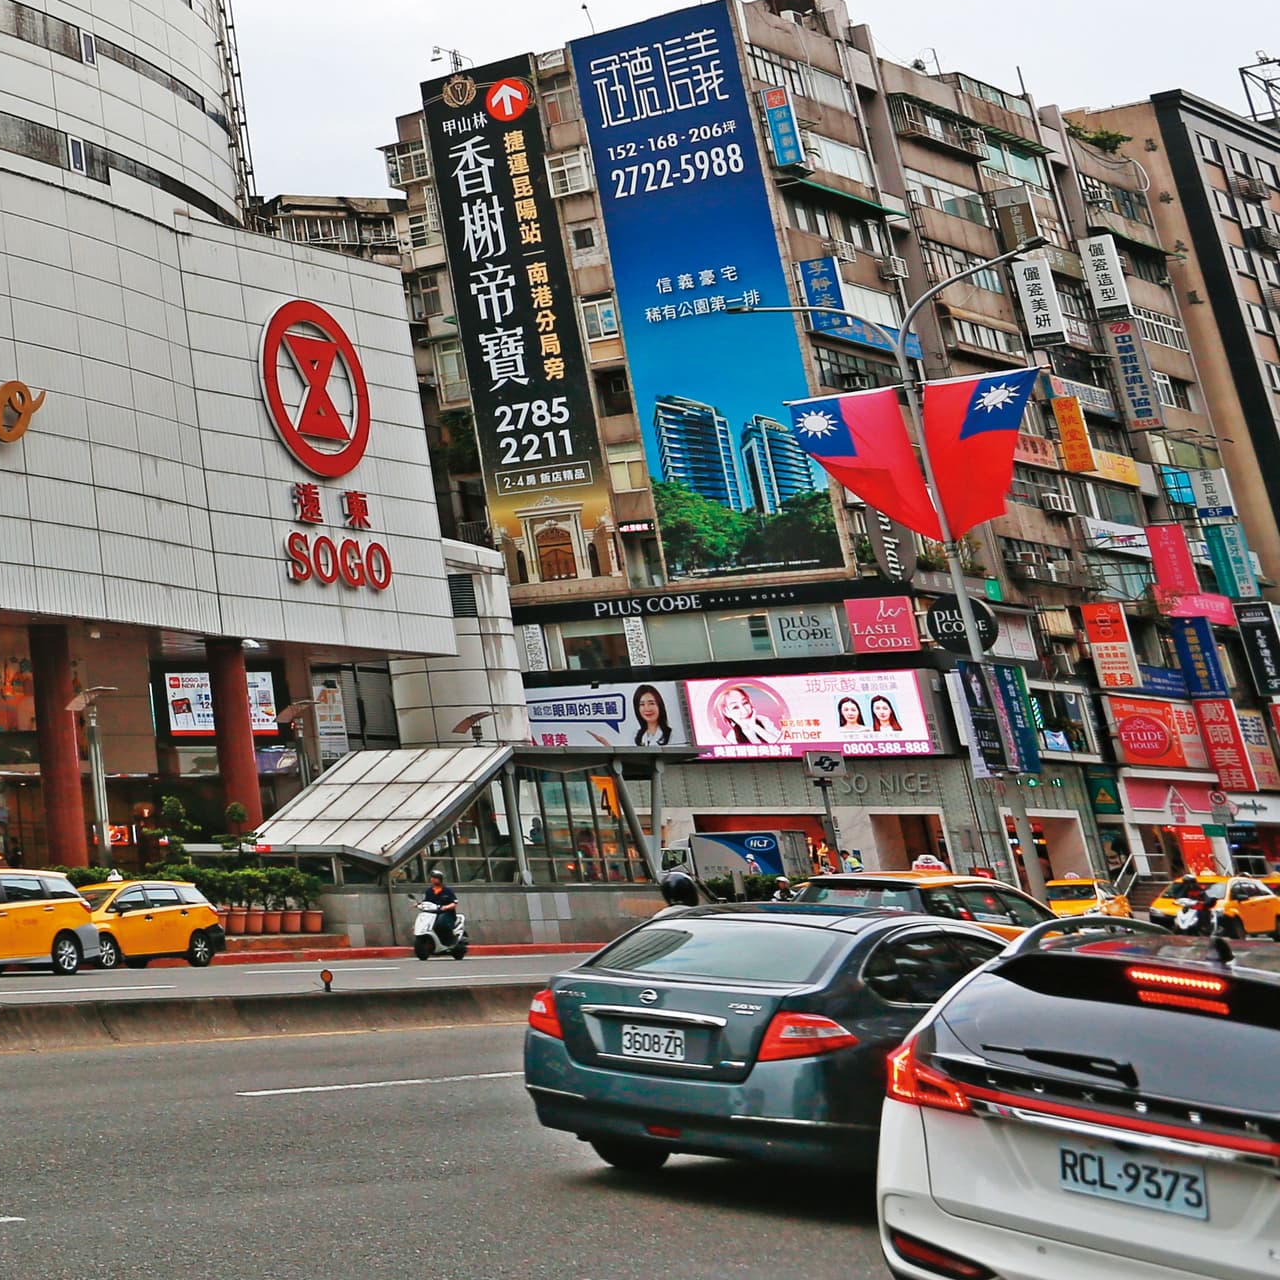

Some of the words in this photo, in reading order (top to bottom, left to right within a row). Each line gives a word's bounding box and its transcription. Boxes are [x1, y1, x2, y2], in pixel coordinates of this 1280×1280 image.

[442, 111, 488, 136] 甲山林
[611, 143, 744, 199] 2722-5988
[448, 135, 530, 393] 香榭帝寶
[503, 130, 543, 245] 捷運昆陽站
[525, 261, 566, 382] 南港分局旁
[656, 265, 739, 295] 信義豪宅
[644, 289, 761, 323] 稀有公園第一排
[494, 397, 570, 433] 2785
[499, 429, 575, 465] 2211
[291, 481, 373, 531] 遠東
[1208, 508, 1223, 517] 5F
[283, 530, 393, 591] SOGO
[593, 599, 642, 617] PLUS
[646, 594, 703, 613] CODE
[750, 591, 796, 601] WORKS
[778, 615, 821, 642] PLUS
[786, 627, 834, 642] CODE
[852, 622, 897, 636] LASH
[865, 636, 914, 649] CODE
[783, 729, 822, 741] Amber
[842, 742, 930, 755] 0800-588-888
[1121, 731, 1166, 742] ETUDE
[1129, 742, 1161, 750] HOUSE
[1199, 702, 1249, 789] 戴爾美語
[840, 774, 868, 795] SO
[880, 773, 932, 793] NICE
[600, 787, 612, 817] 4
[623, 1030, 684, 1057] 3608-ZR
[1059, 1148, 1205, 1210] RCL-9373
